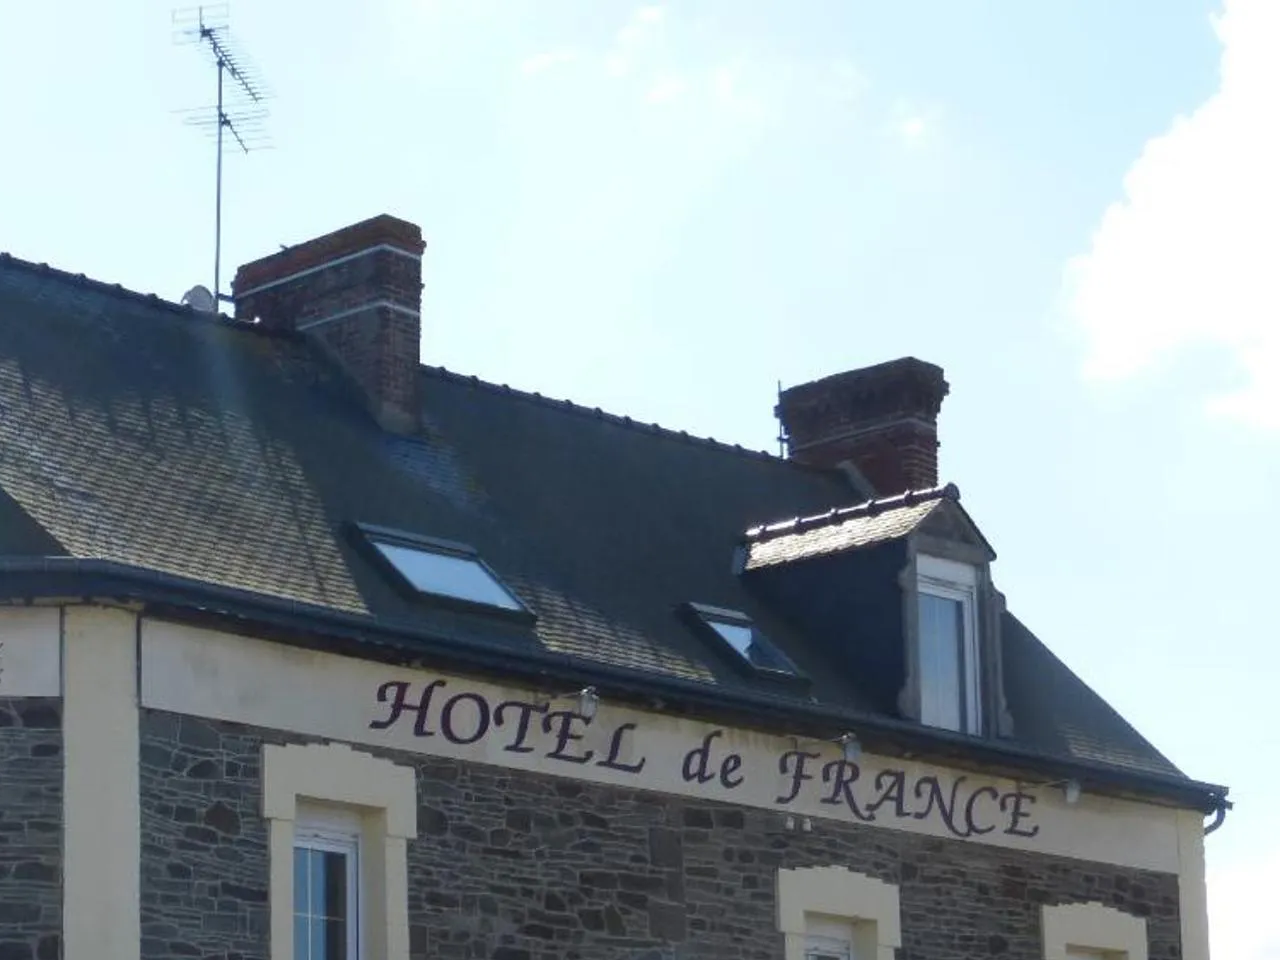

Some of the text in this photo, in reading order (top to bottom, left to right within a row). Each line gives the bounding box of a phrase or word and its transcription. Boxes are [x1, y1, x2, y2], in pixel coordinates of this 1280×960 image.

[369, 679, 1040, 839] HOTEL de FRANCE
